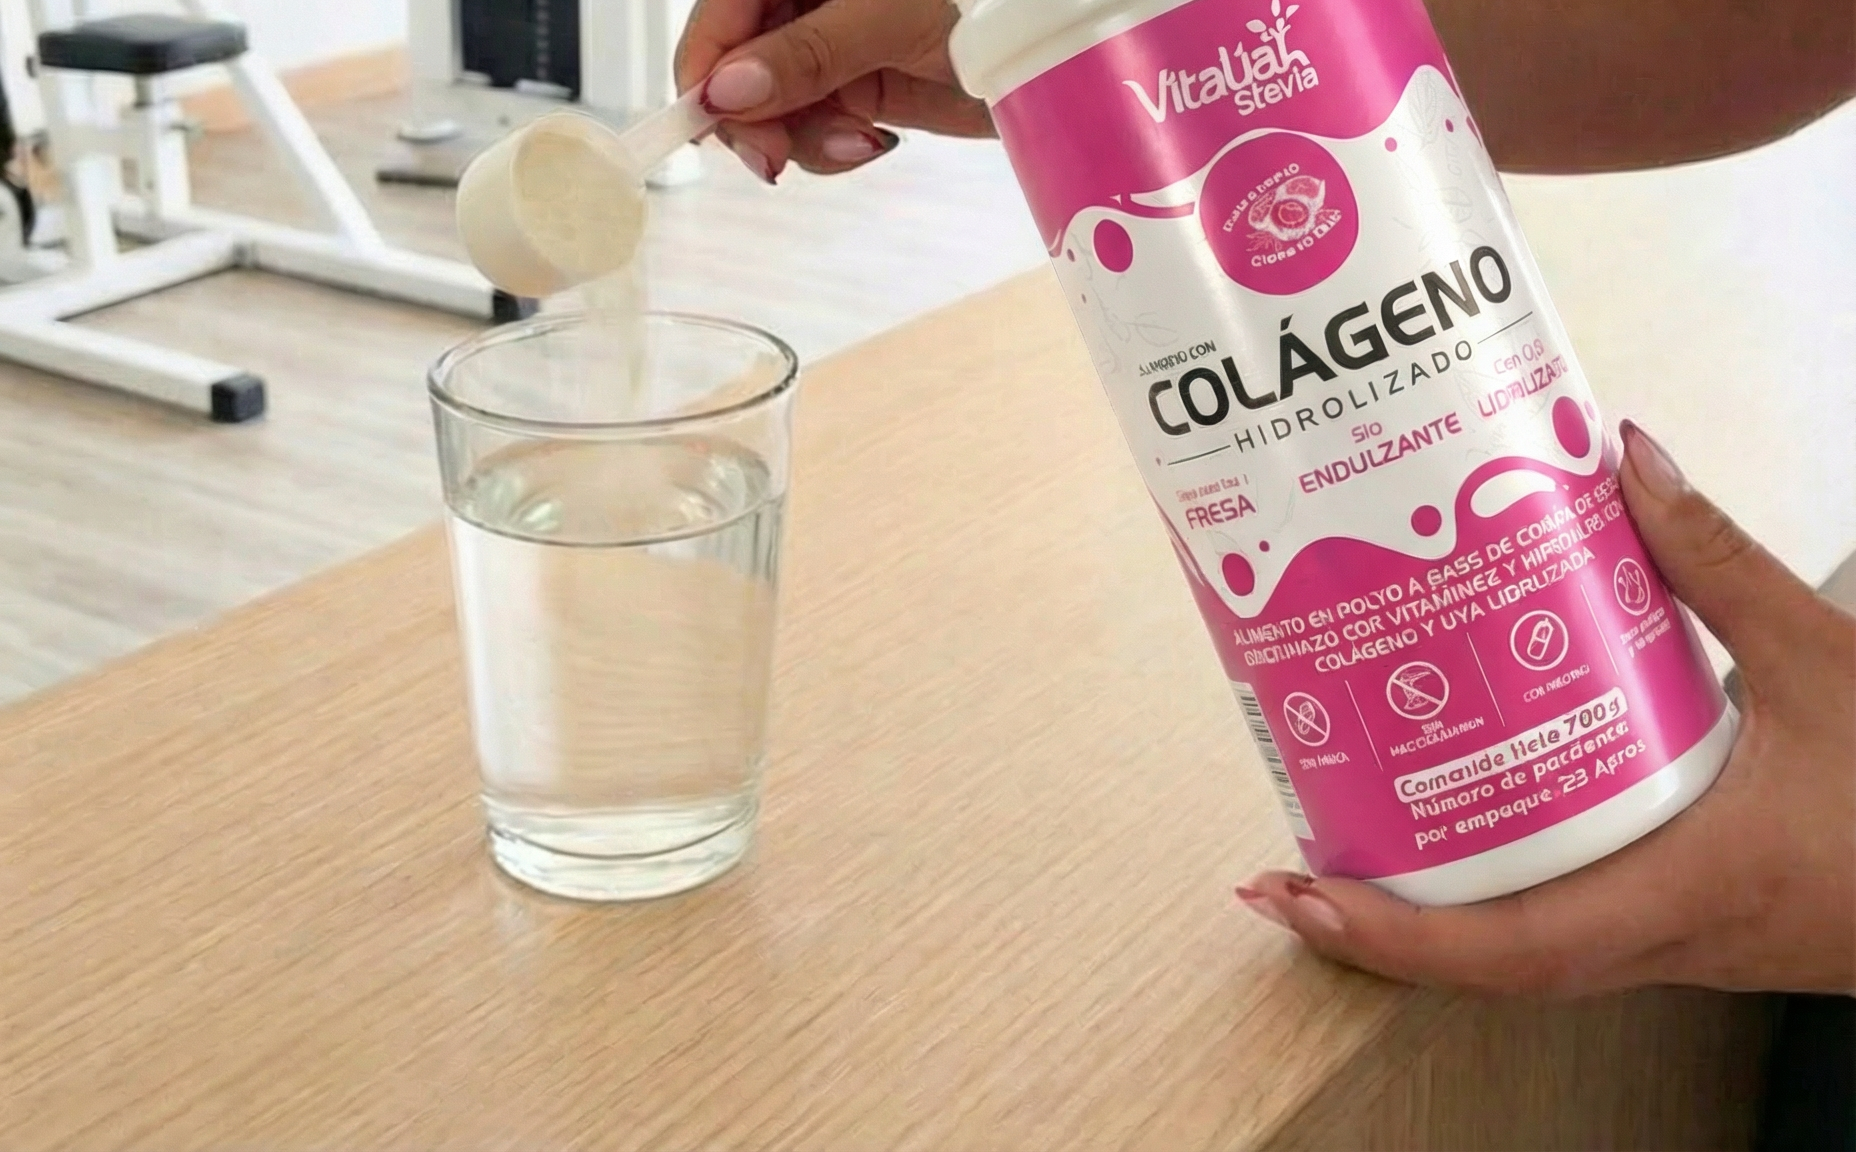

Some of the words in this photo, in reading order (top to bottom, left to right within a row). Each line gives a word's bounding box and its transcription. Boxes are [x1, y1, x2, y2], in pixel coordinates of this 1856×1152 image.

[1148, 245, 1512, 436] COLÁGENO
[1188, 339, 1217, 360] CON
[1233, 339, 1473, 454] HIDROLIZADO
[1298, 411, 1463, 494] ENDULZANTE
[1185, 493, 1257, 530] FRESA
[1409, 577, 1425, 597] A
[1485, 537, 1515, 563] DE
[1502, 559, 1516, 578] Y
[1420, 619, 1435, 638] Y
[1440, 601, 1485, 630] UYA
[1500, 771, 1527, 791] de
